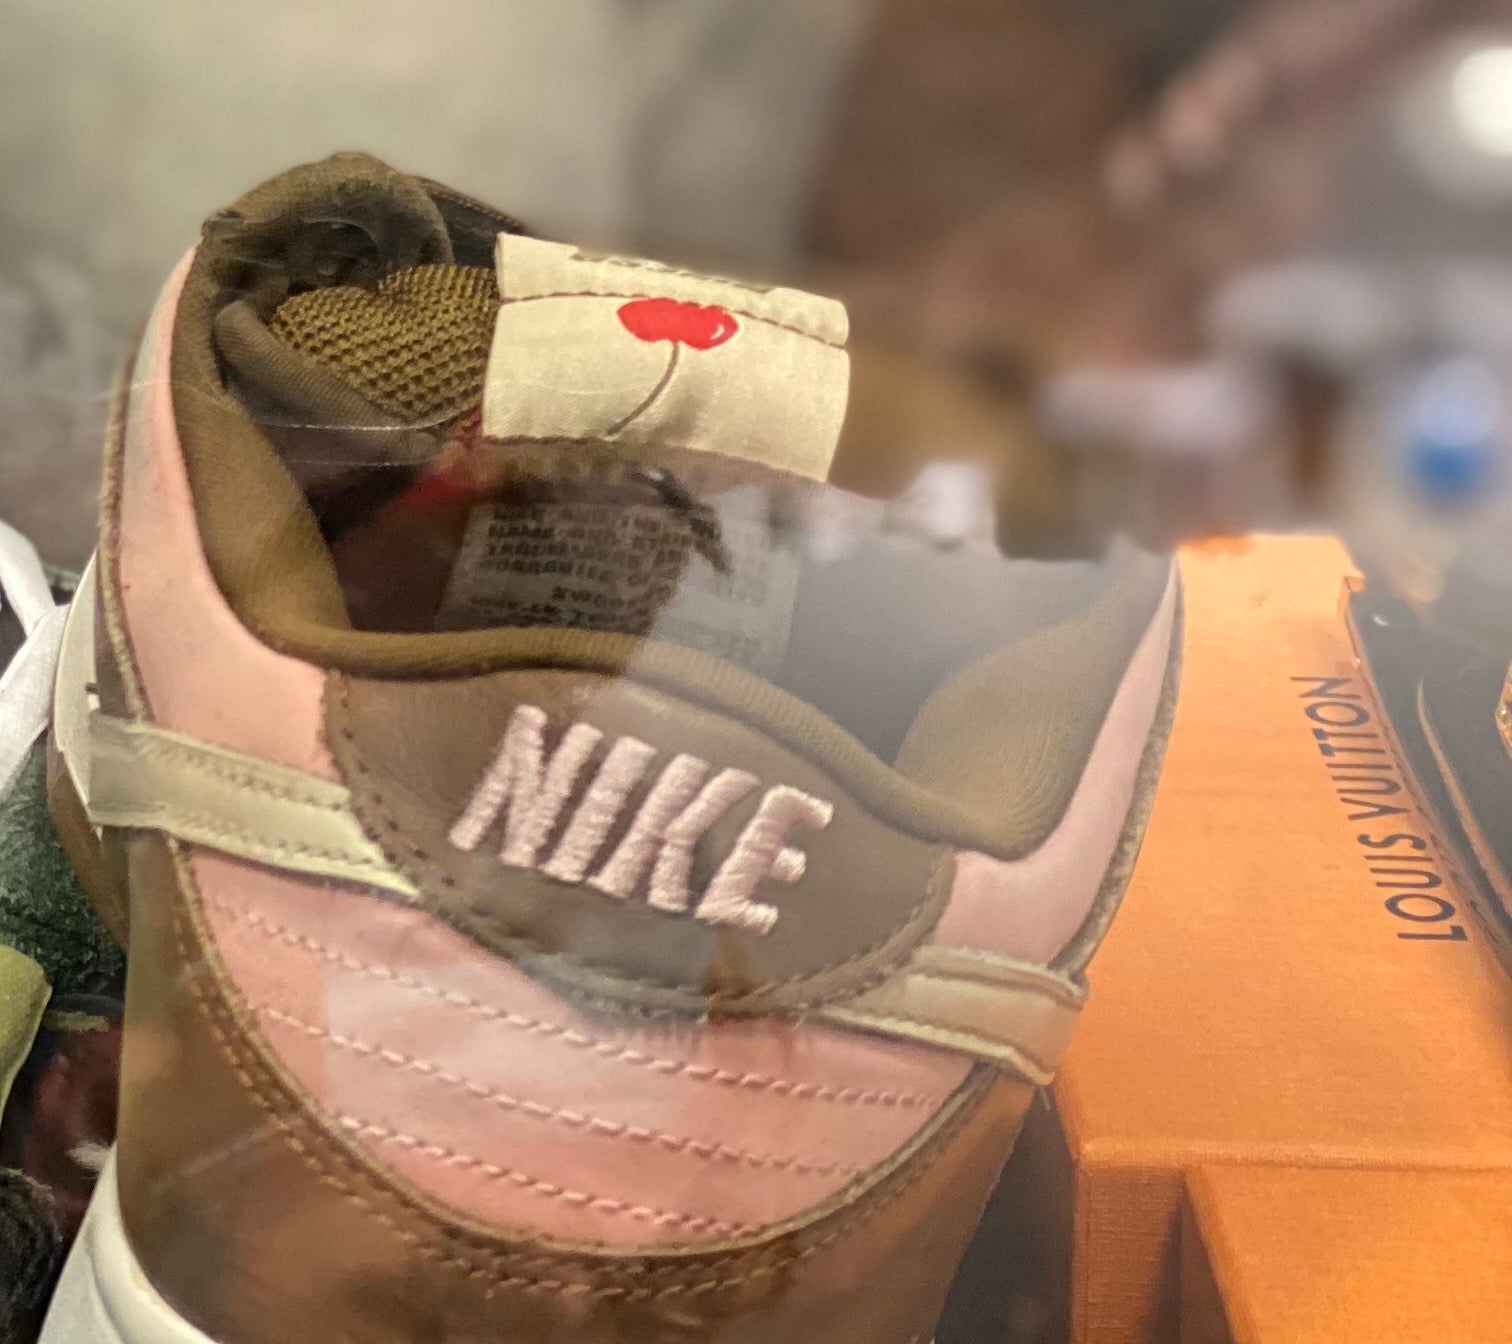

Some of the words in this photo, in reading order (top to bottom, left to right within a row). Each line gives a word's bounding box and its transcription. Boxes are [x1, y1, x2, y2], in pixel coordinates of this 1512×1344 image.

[448, 703, 835, 936] NIKE
[1289, 675, 1413, 821] VUITTON
[1356, 833, 1469, 942] LOUIS
